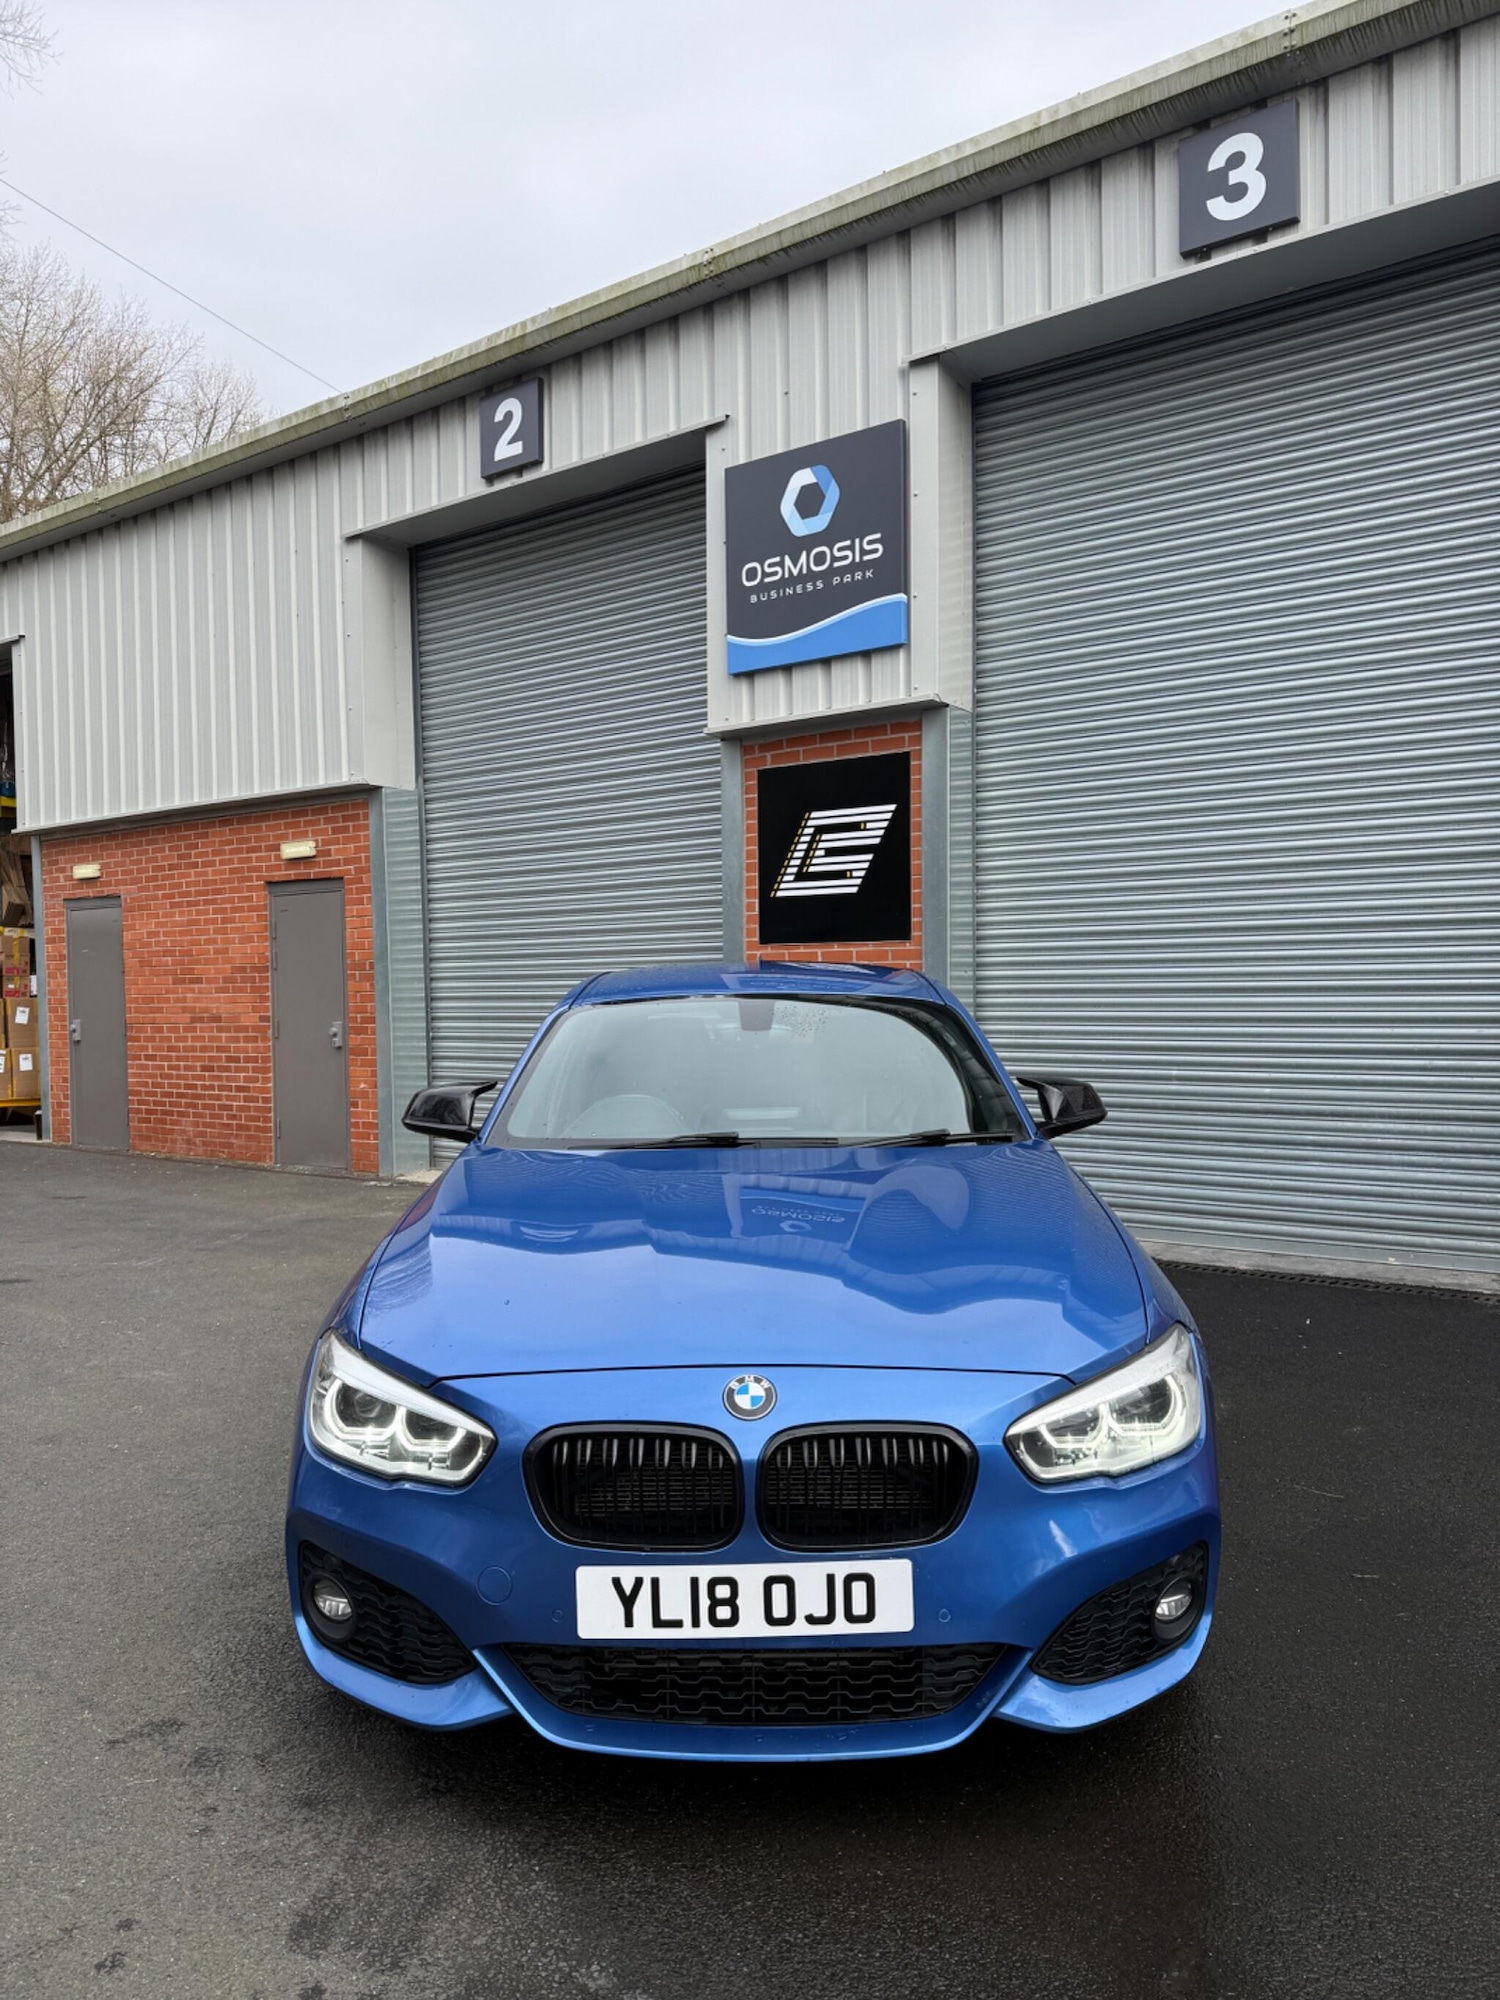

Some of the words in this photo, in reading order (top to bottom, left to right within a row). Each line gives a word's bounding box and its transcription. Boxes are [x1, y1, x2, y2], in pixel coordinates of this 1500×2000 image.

[1206, 132, 1267, 221] 3
[494, 398, 523, 462] 2
[742, 533, 884, 587] OSMOSIS
[750, 580, 824, 603] BUSINESS
[833, 569, 874, 586] PARK
[611, 1576, 740, 1629] YL18
[763, 1572, 876, 1627] OJO
